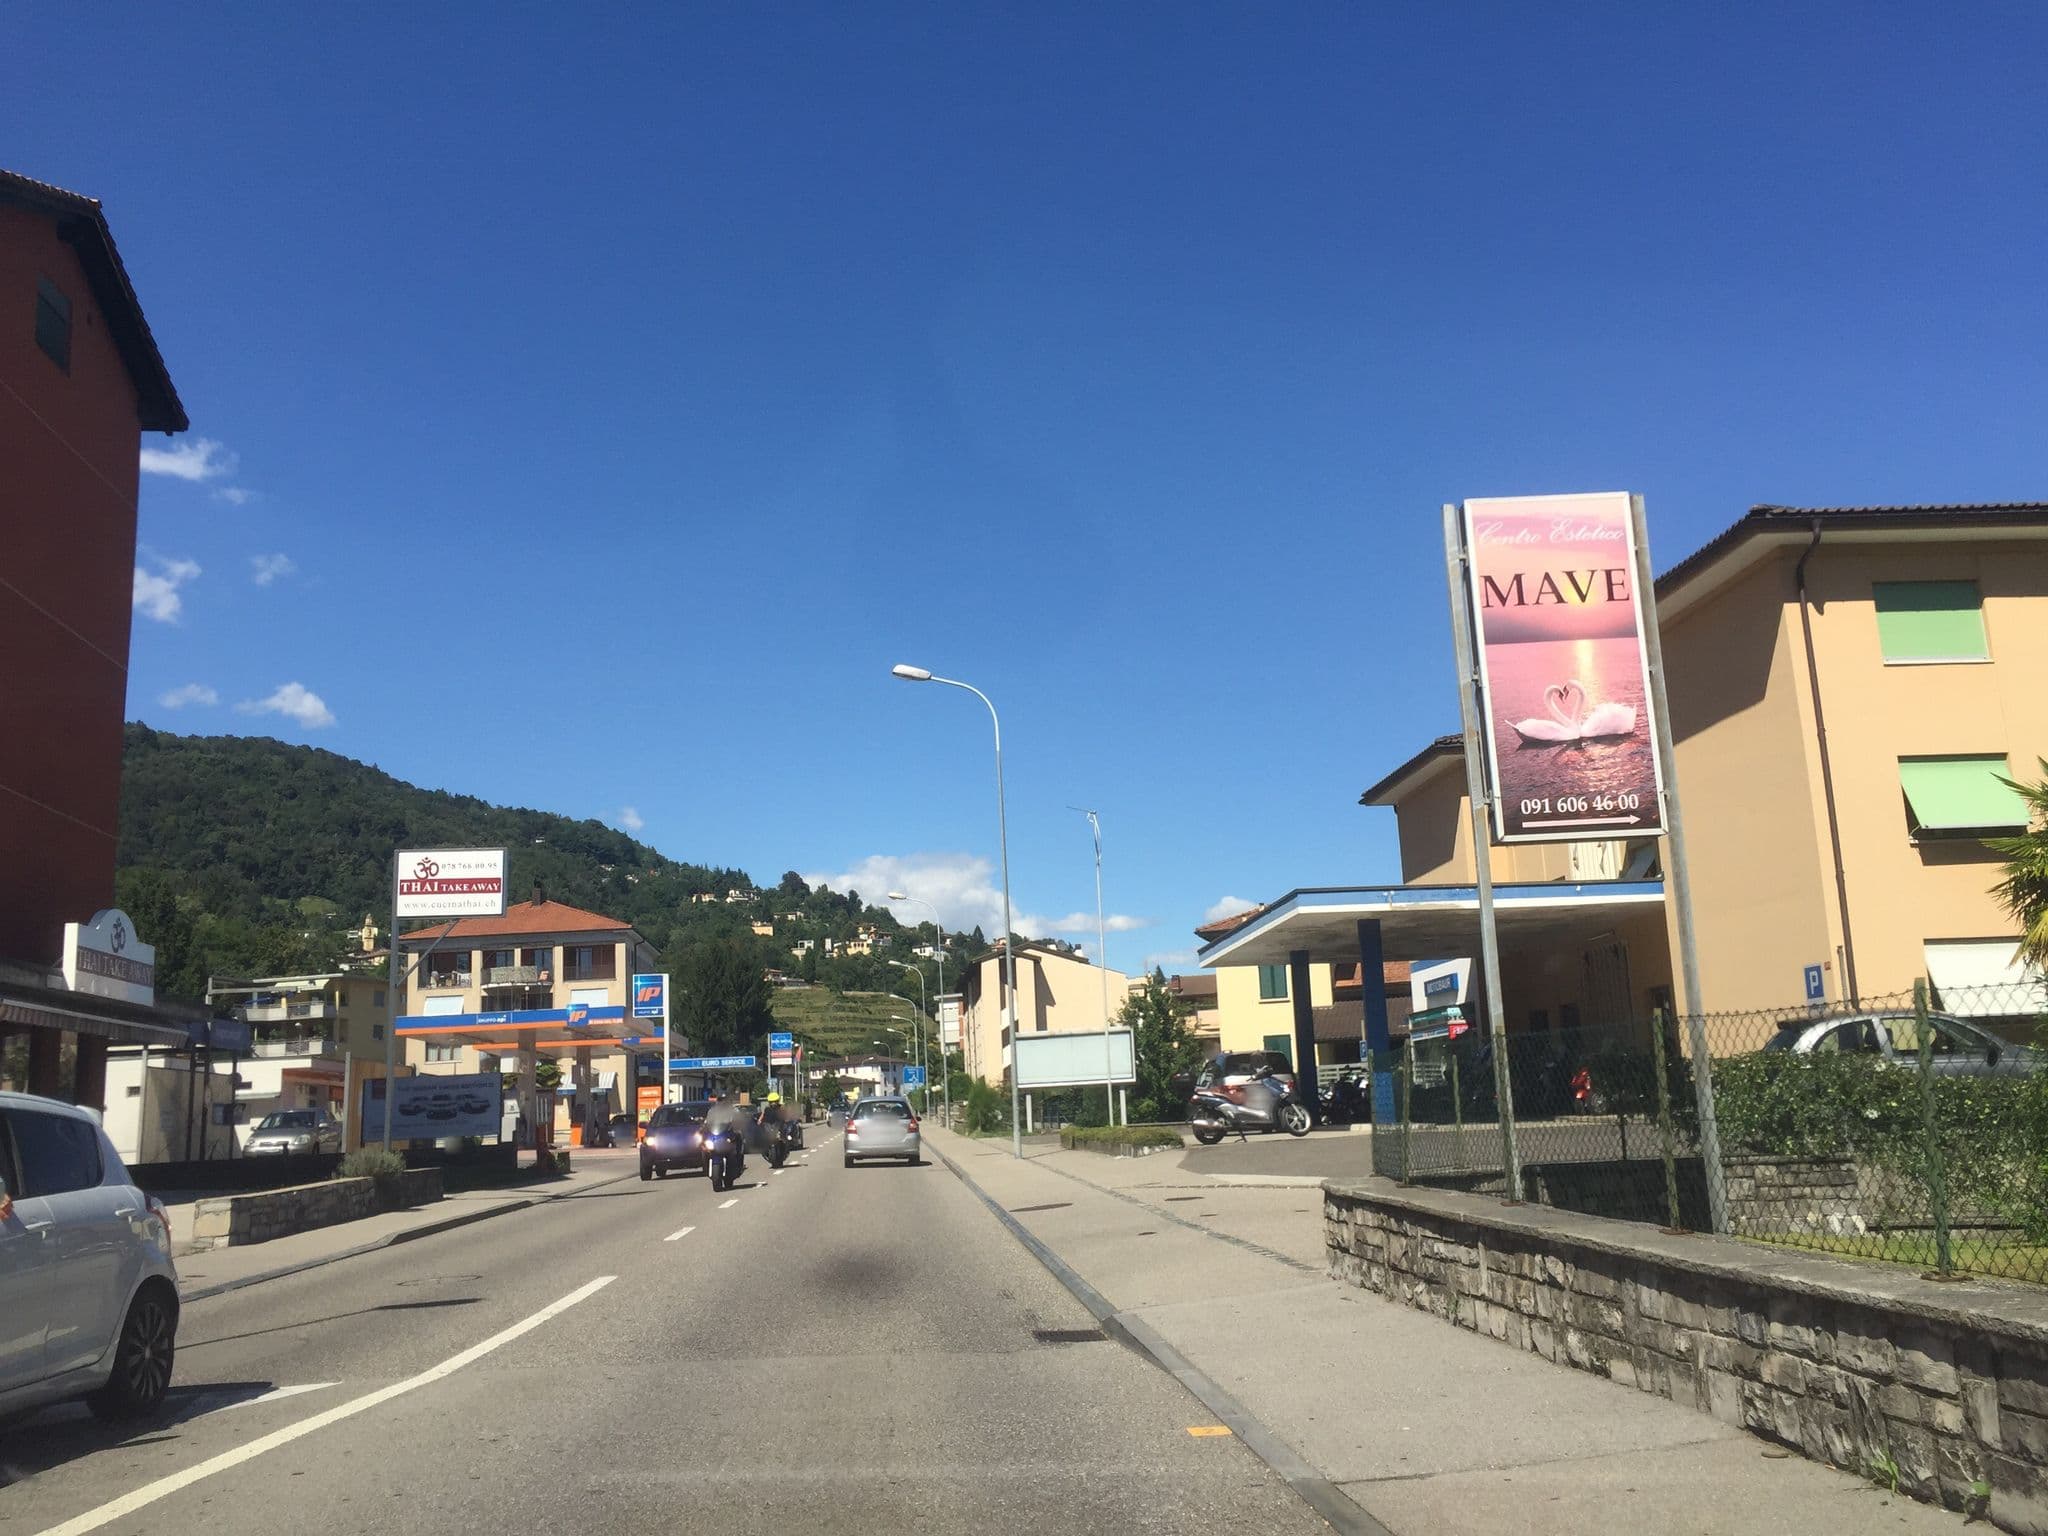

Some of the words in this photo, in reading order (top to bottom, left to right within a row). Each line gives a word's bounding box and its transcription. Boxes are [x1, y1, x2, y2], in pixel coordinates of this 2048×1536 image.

[1477, 521, 1542, 545] Centro
[1549, 518, 1625, 544] Estetico
[1480, 568, 1630, 608] MAVE
[1520, 798, 1553, 815] 091
[1556, 796, 1588, 813] 606
[1592, 795, 1614, 811] 46
[1617, 794, 1639, 810] 00
[400, 881, 439, 893] THAI
[441, 883, 469, 892] TAKE
[470, 882, 500, 892] AWAY
[1809, 970, 1819, 995] P
[636, 986, 661, 1002] IP
[569, 1010, 587, 1022] IP
[701, 1059, 719, 1067] EURO
[721, 1058, 746, 1066] SERVICE
